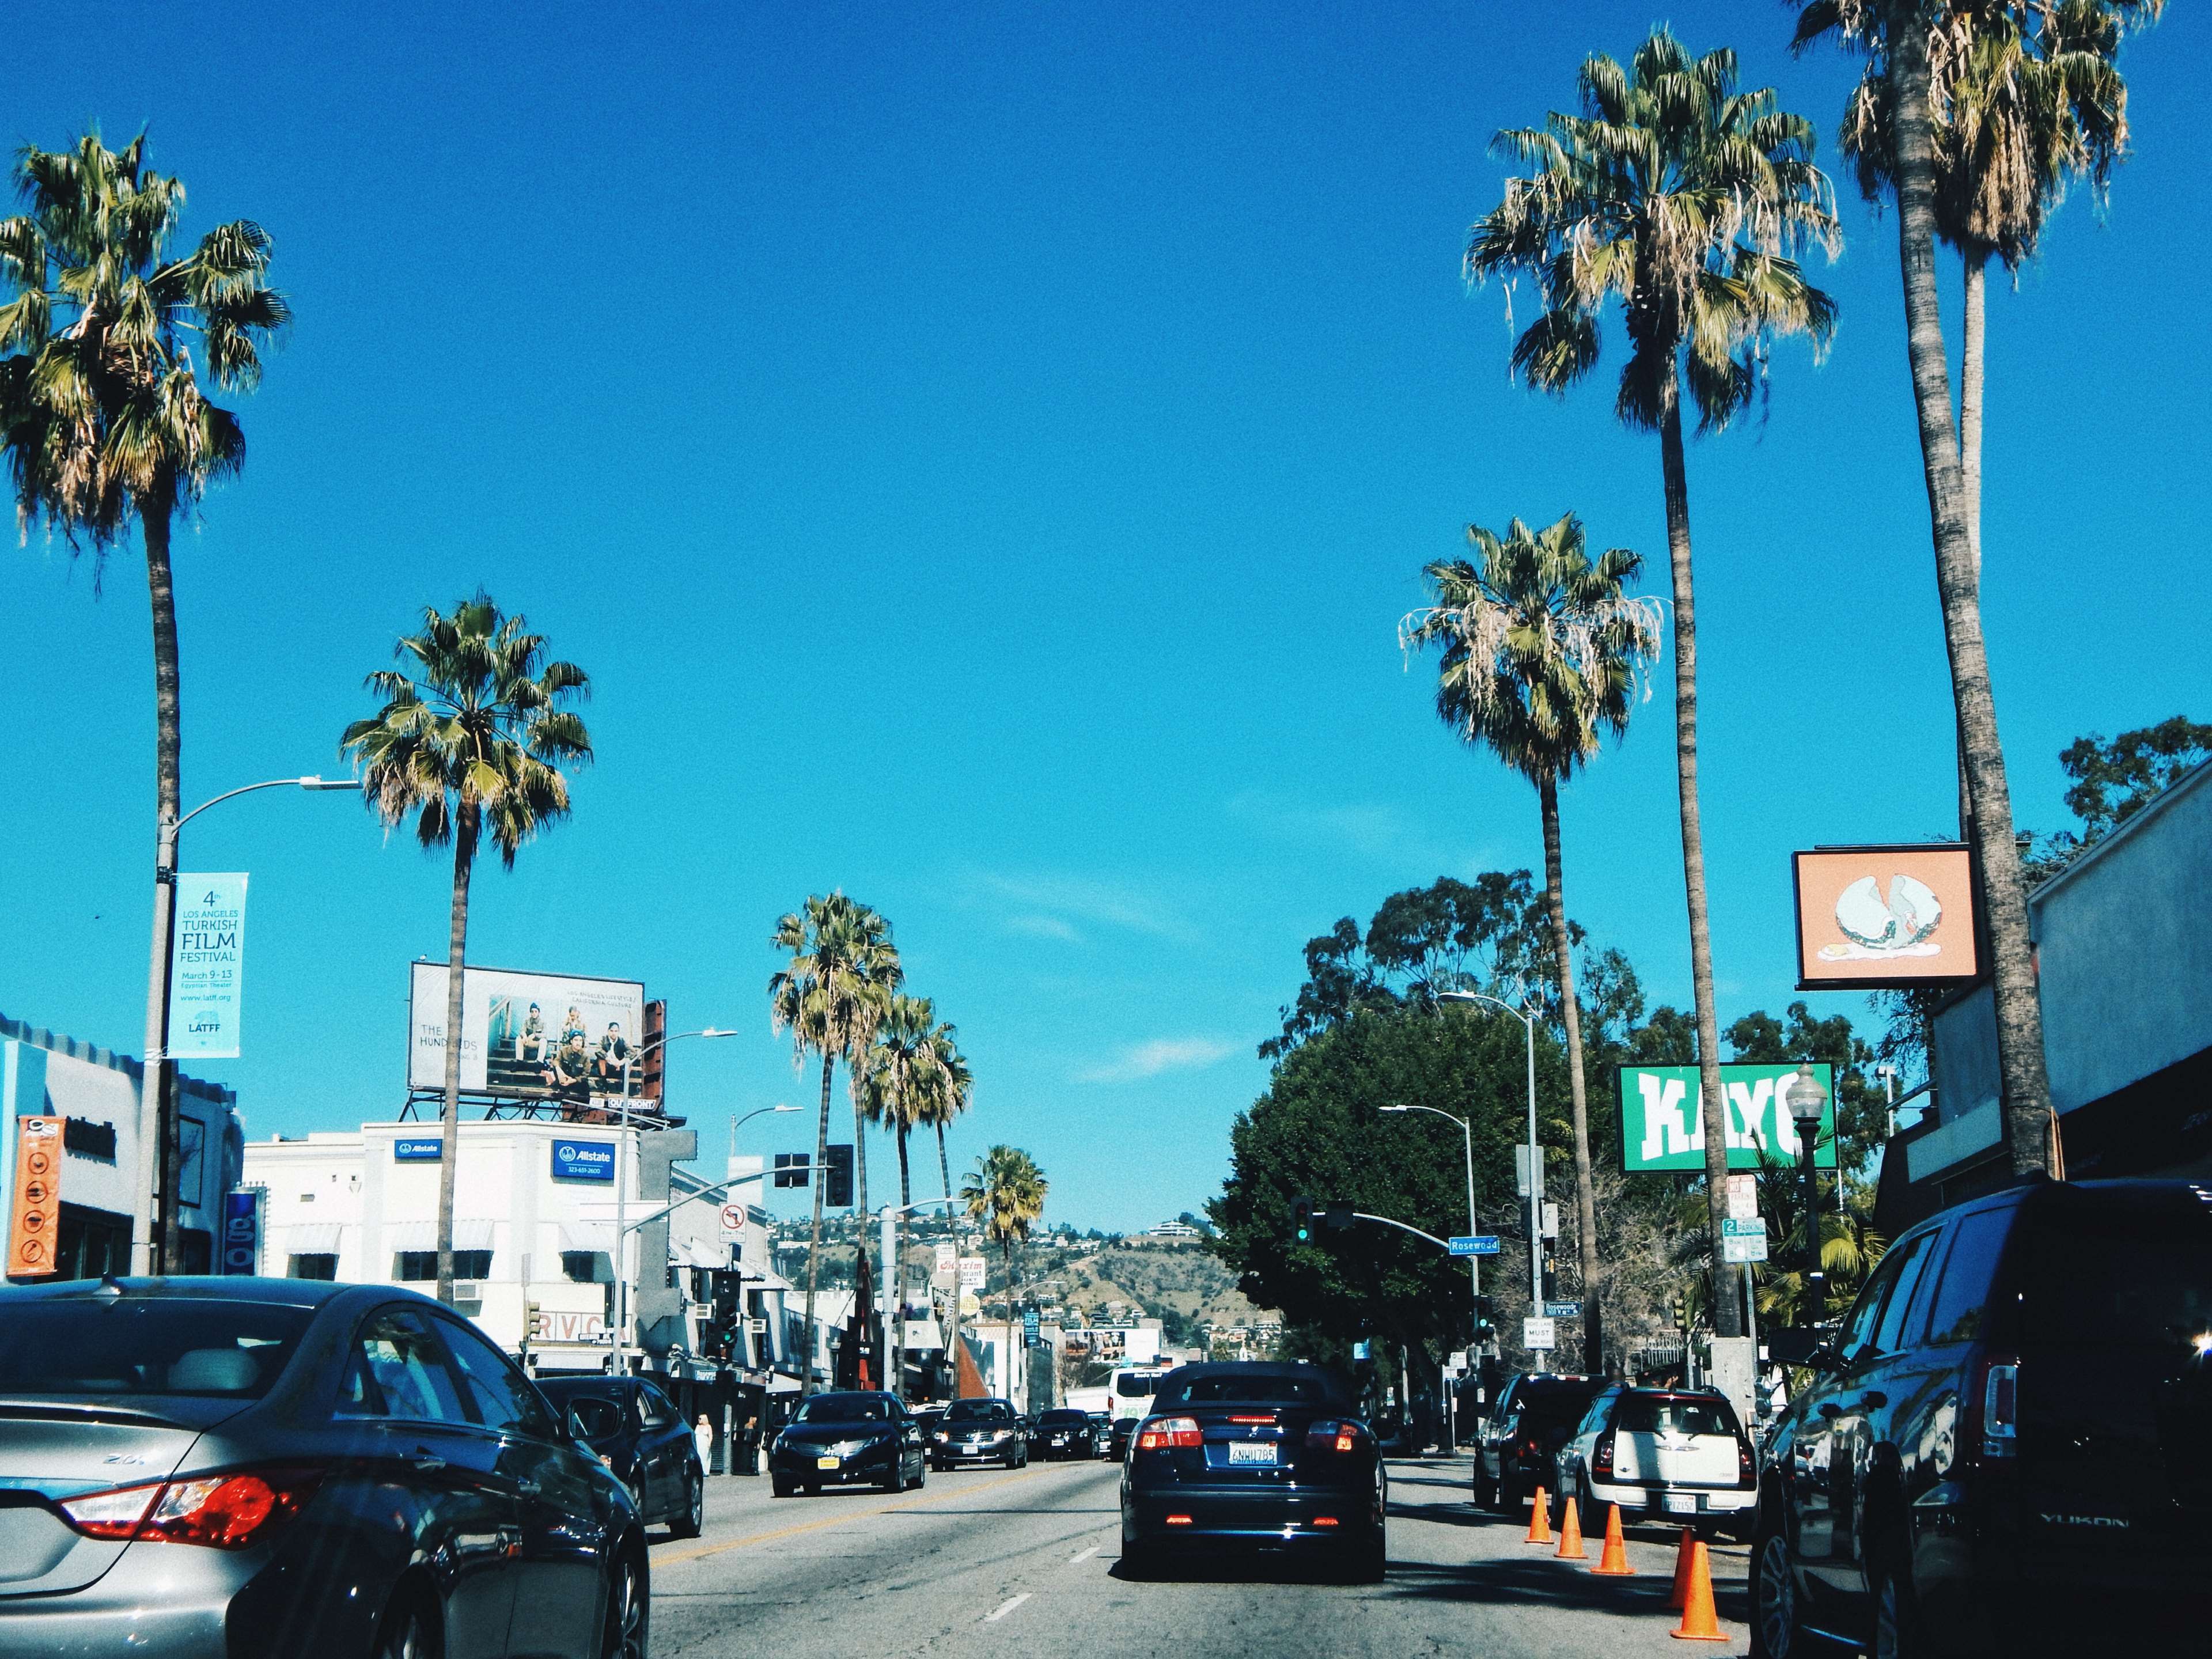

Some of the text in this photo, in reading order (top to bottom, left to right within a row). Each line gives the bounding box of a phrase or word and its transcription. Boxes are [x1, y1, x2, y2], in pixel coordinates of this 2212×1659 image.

[203, 891, 221, 907] 4th
[181, 920, 237, 931] TURKISH
[182, 933, 236, 950] FILM
[180, 952, 236, 962] FESTIVAL
[189, 1024, 221, 1032] LATFF
[421, 1025, 442, 1036] THE
[421, 1037, 478, 1051] HUNDDS
[610, 1100, 653, 1108] OUFRONT
[577, 1150, 611, 1162] Allstate
[1726, 1221, 1734, 1231] 2
[1452, 1241, 1497, 1250] Rosewood
[940, 1260, 982, 1270] Mxim
[2041, 1514, 2129, 1527] YUKON
